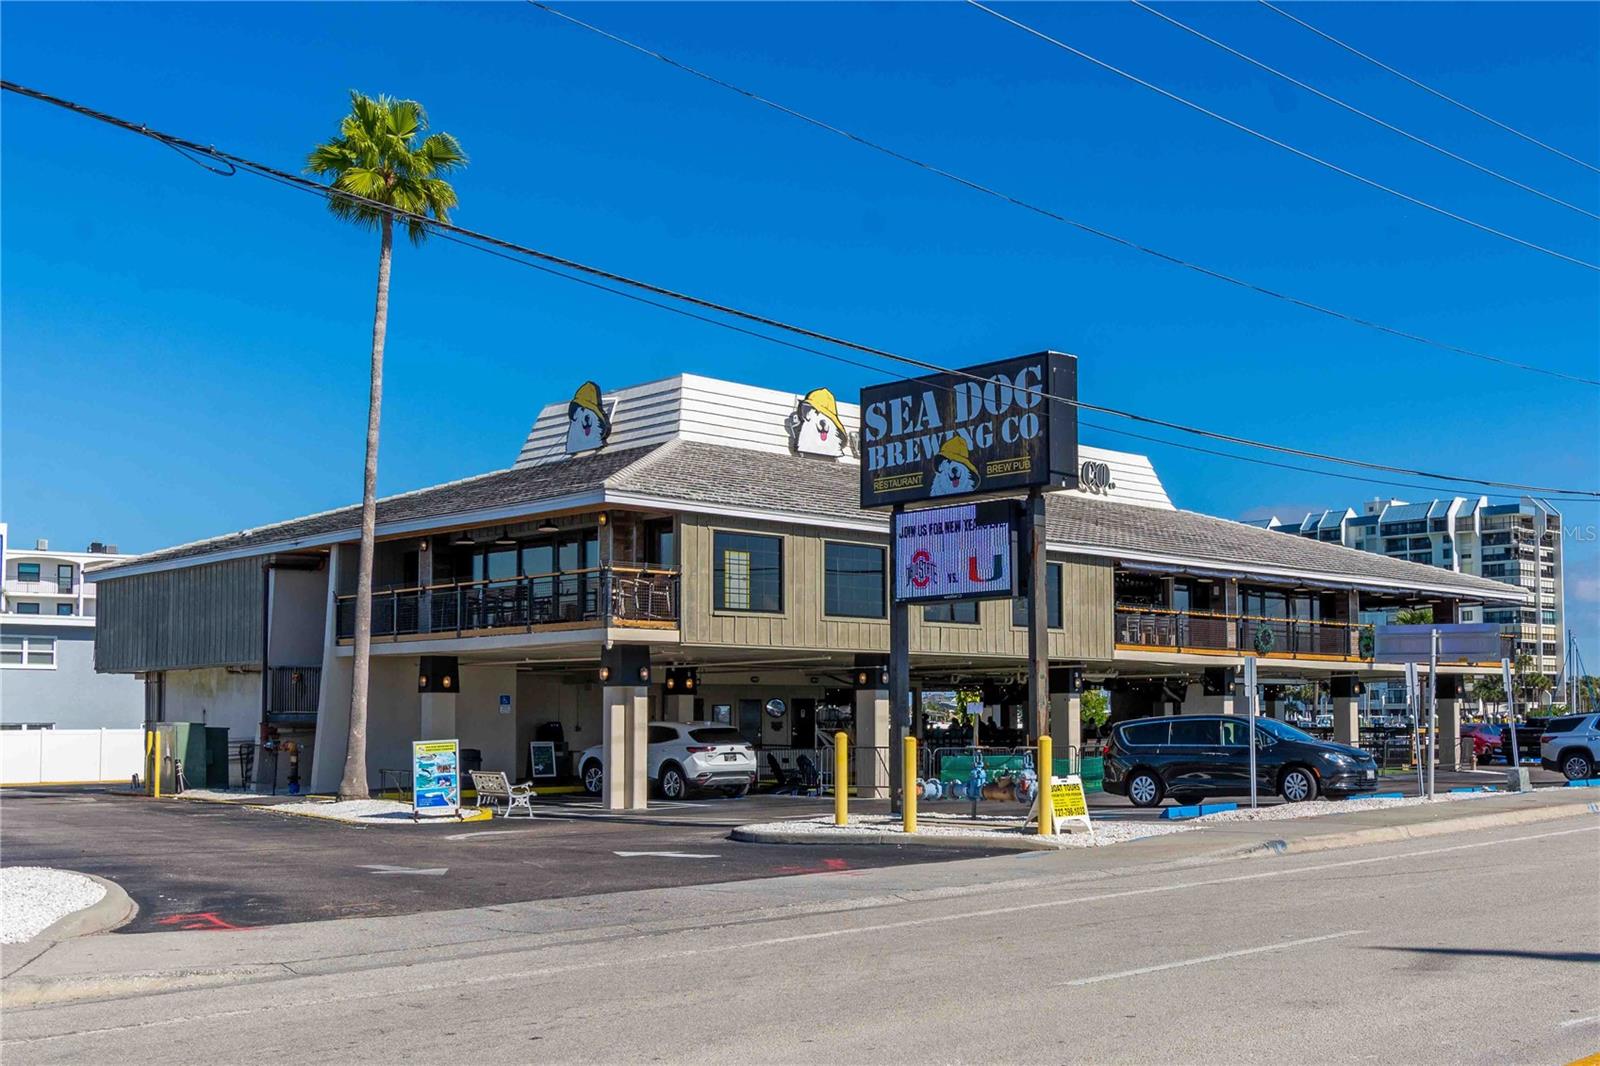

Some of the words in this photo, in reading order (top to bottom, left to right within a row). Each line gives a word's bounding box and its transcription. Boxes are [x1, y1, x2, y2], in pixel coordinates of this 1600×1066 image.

[865, 390, 943, 442] SEA
[953, 364, 1043, 423] DOG
[986, 462, 1012, 474] BREW
[1013, 460, 1031, 470] PUB
[873, 475, 923, 491] RESTAURANT
[899, 525, 917, 539] JOIN
[917, 524, 928, 536] US
[928, 521, 943, 535] FOR
[944, 520, 962, 533] NEW
[1063, 783, 1080, 791] TOURS
